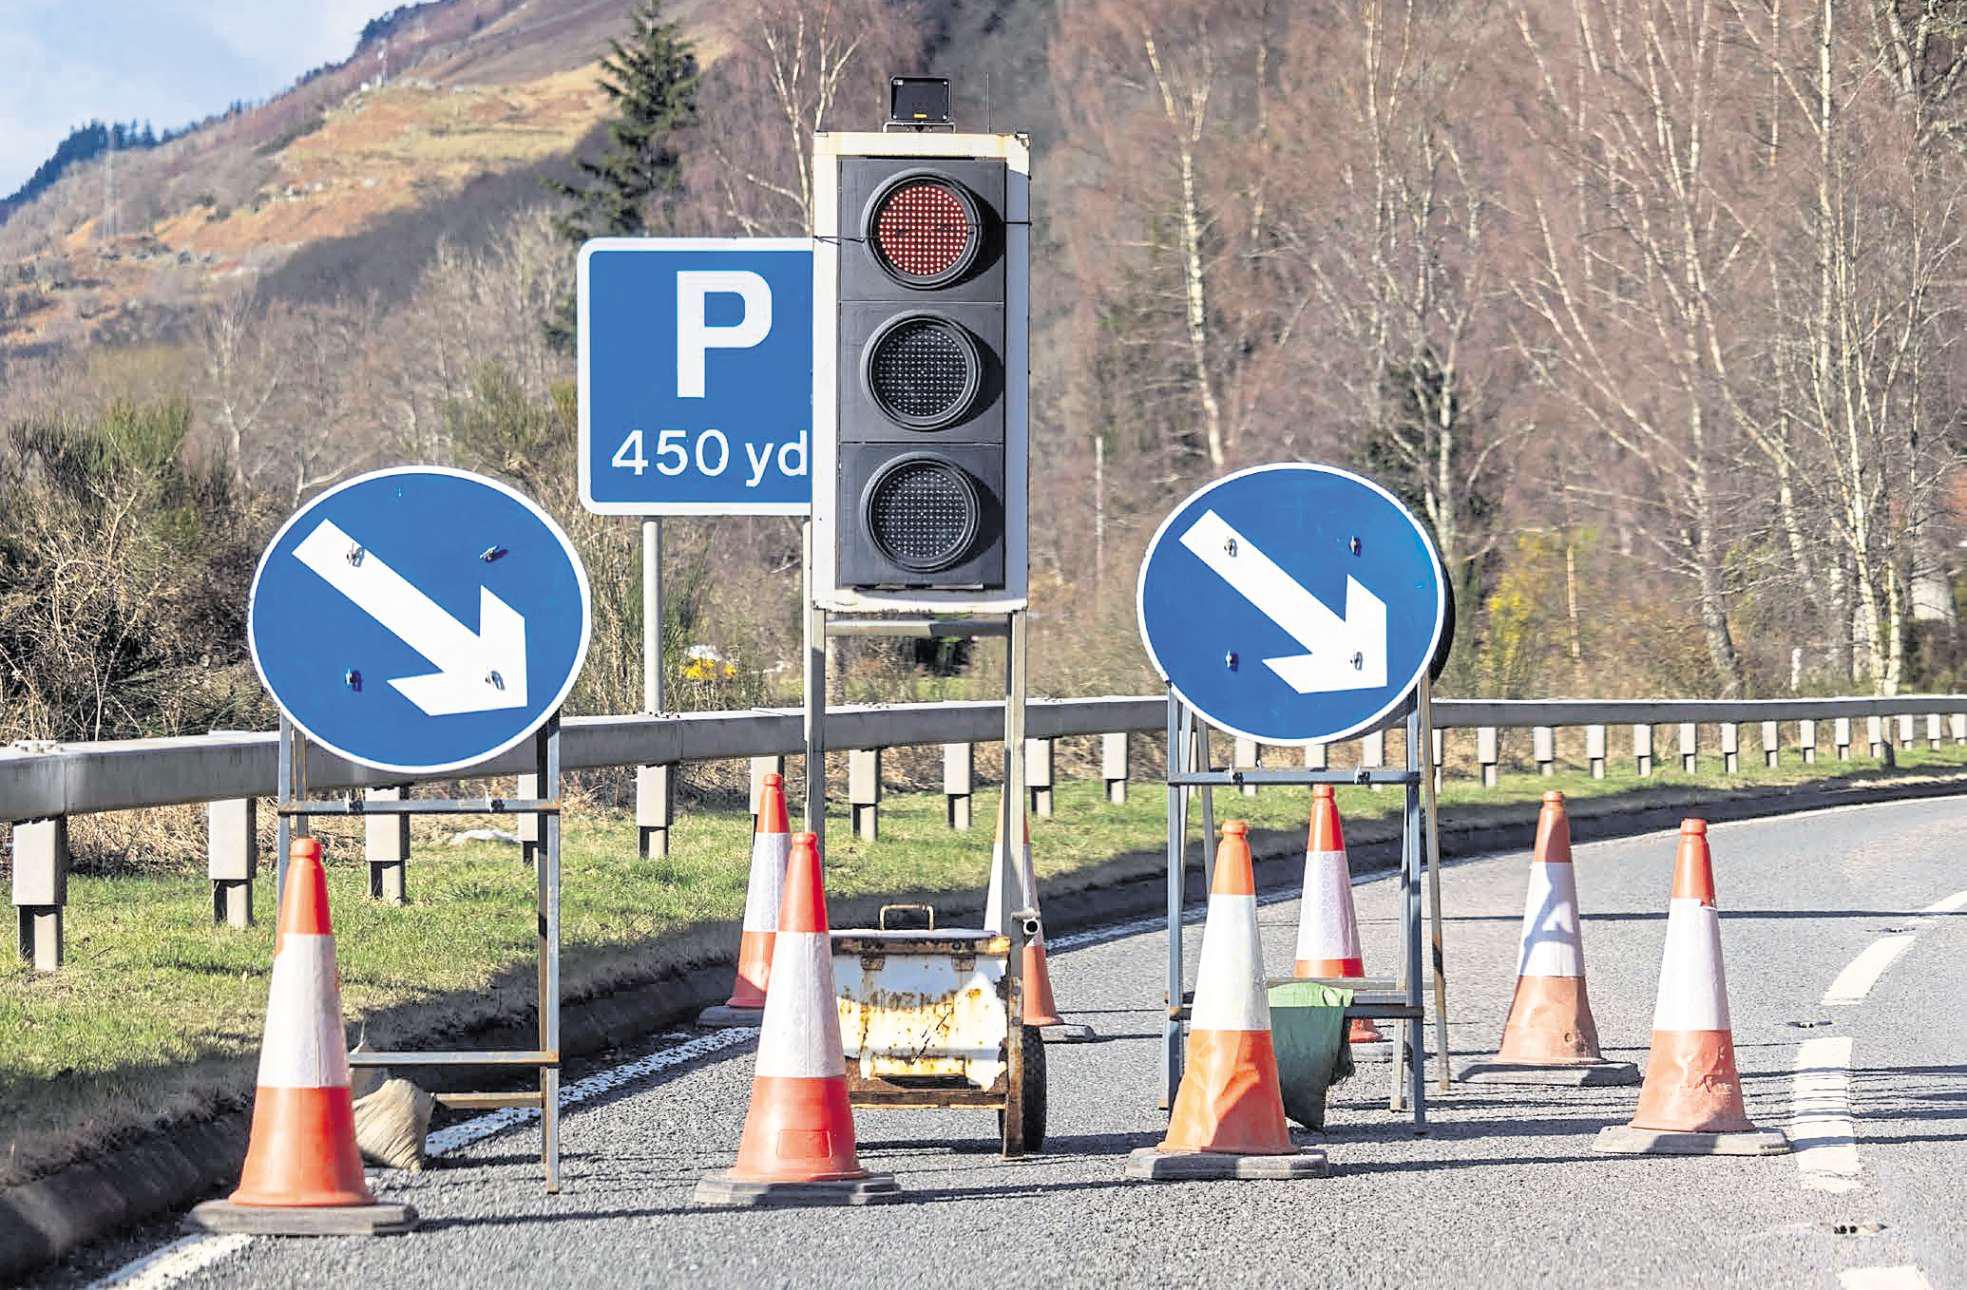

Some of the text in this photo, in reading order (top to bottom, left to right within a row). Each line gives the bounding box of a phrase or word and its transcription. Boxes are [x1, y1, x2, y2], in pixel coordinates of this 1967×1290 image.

[677, 271, 772, 397] P
[612, 430, 807, 487] 450 yd
